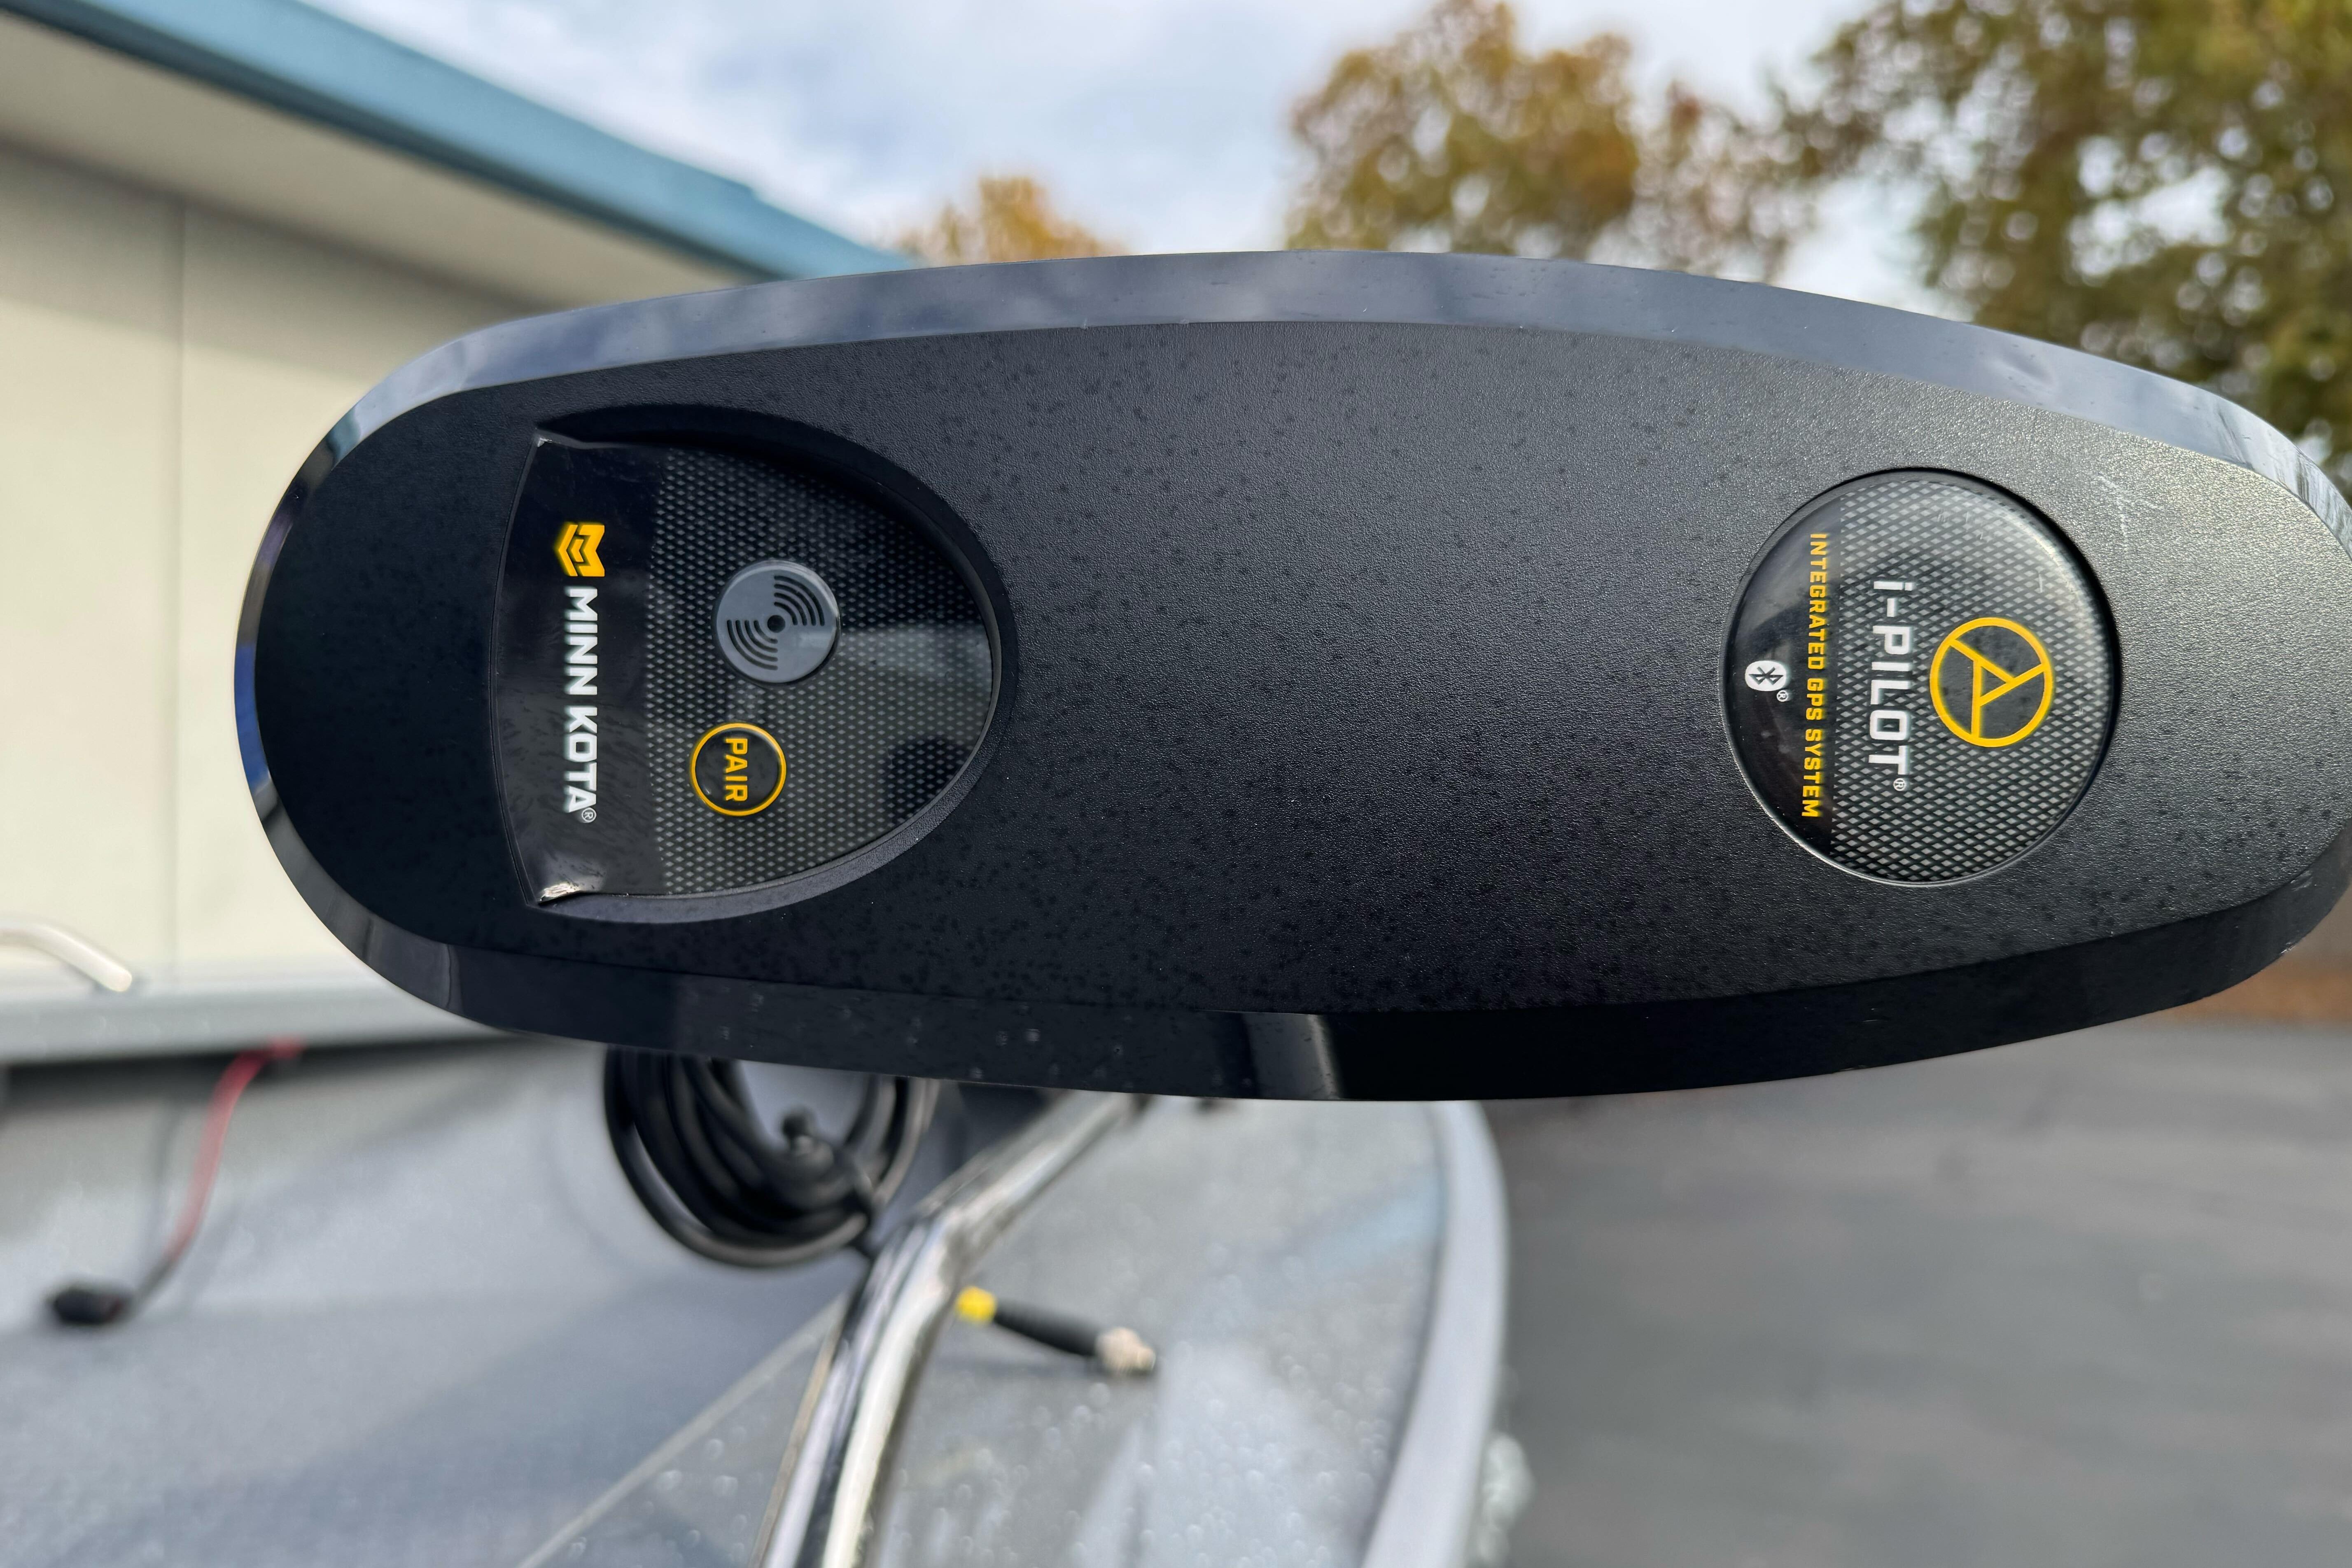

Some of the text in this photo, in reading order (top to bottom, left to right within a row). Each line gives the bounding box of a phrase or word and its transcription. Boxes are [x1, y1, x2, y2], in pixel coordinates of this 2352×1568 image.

[566, 586, 598, 696] MINN
[1801, 533, 1827, 817] INTEGRATED GPS SYSTEM
[724, 738, 748, 801] PAIR
